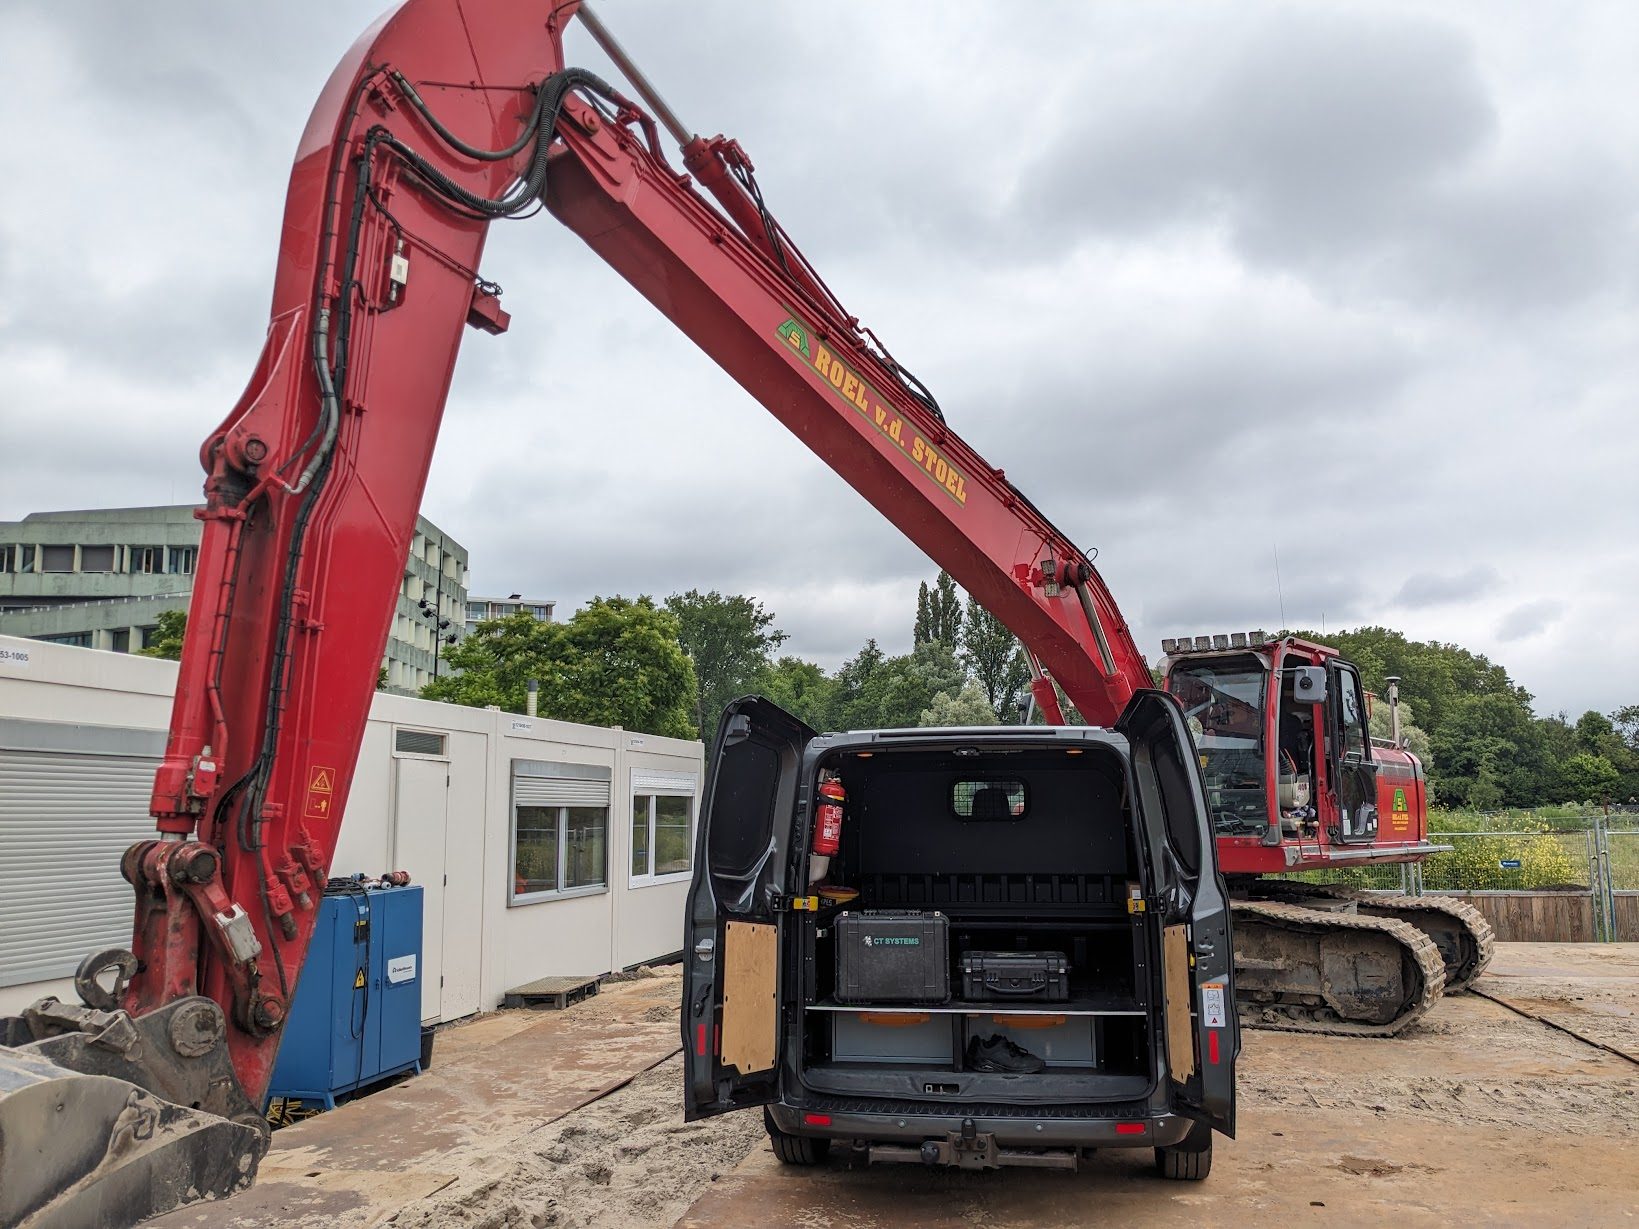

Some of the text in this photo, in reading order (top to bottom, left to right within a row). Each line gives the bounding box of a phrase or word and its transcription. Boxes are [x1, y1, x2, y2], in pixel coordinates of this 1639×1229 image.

[814, 344, 967, 503] ROEL v.d. STOEL
[873, 937, 920, 945] CT SYSTEMS
